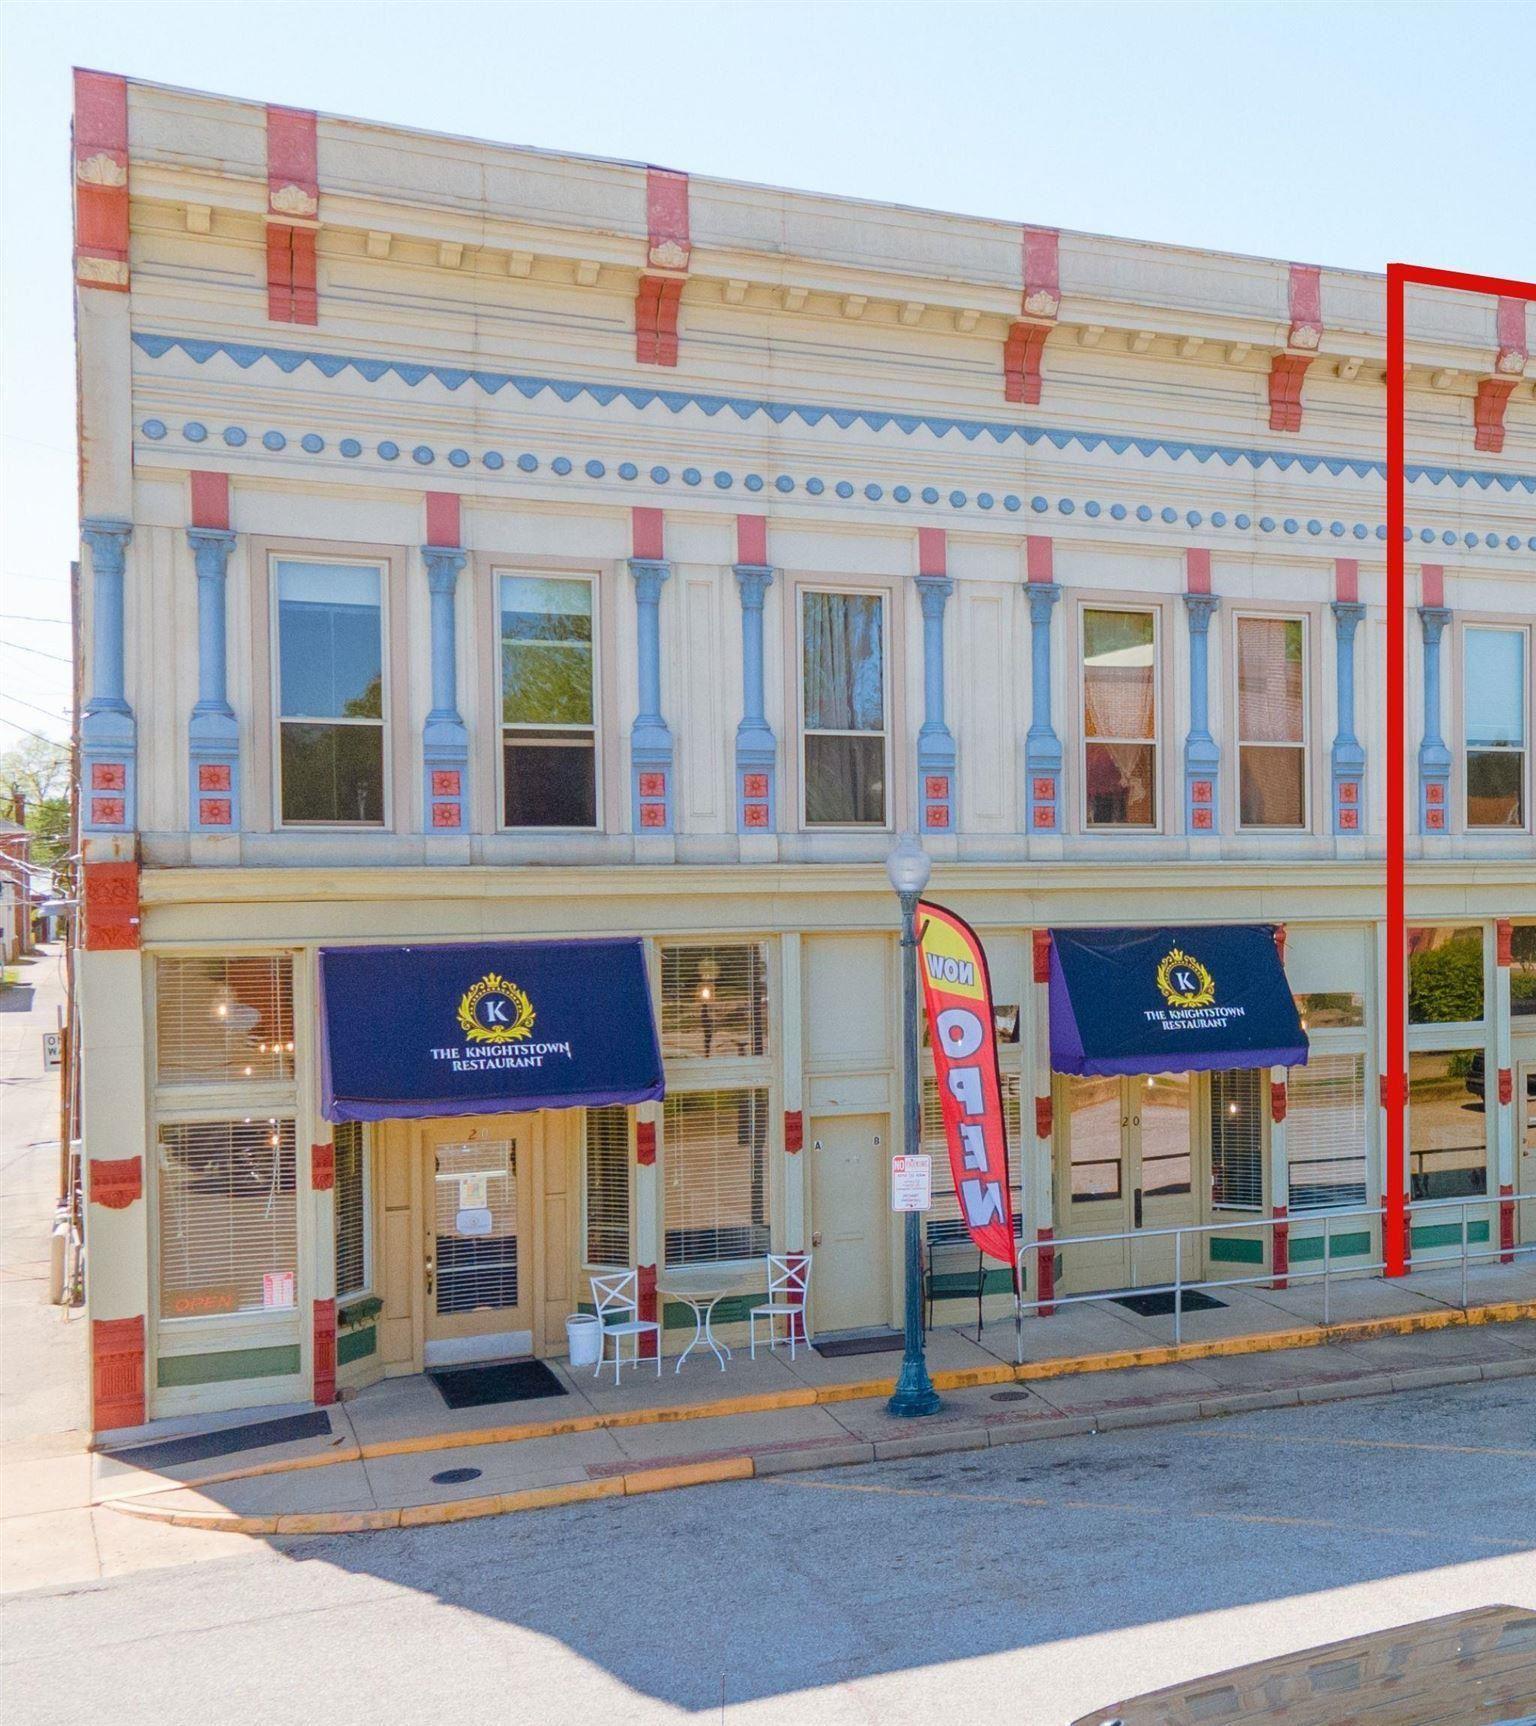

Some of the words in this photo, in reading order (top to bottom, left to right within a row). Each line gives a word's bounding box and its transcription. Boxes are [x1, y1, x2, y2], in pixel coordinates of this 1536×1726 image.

[1175, 972, 1195, 990] K
[485, 1001, 509, 1022] K
[1144, 1010, 1166, 1021] THE
[1169, 1007, 1245, 1020] KNIGHTSTOWN
[1162, 1018, 1227, 1030] RESTAURANT
[430, 1048, 460, 1060] THE
[466, 1041, 572, 1059] KNIGHTSTOWN
[453, 1056, 543, 1071] RESTAURANT
[814, 1141, 822, 1150] A
[894, 1159, 905, 1171] NO
[175, 1295, 234, 1312] OPEN
